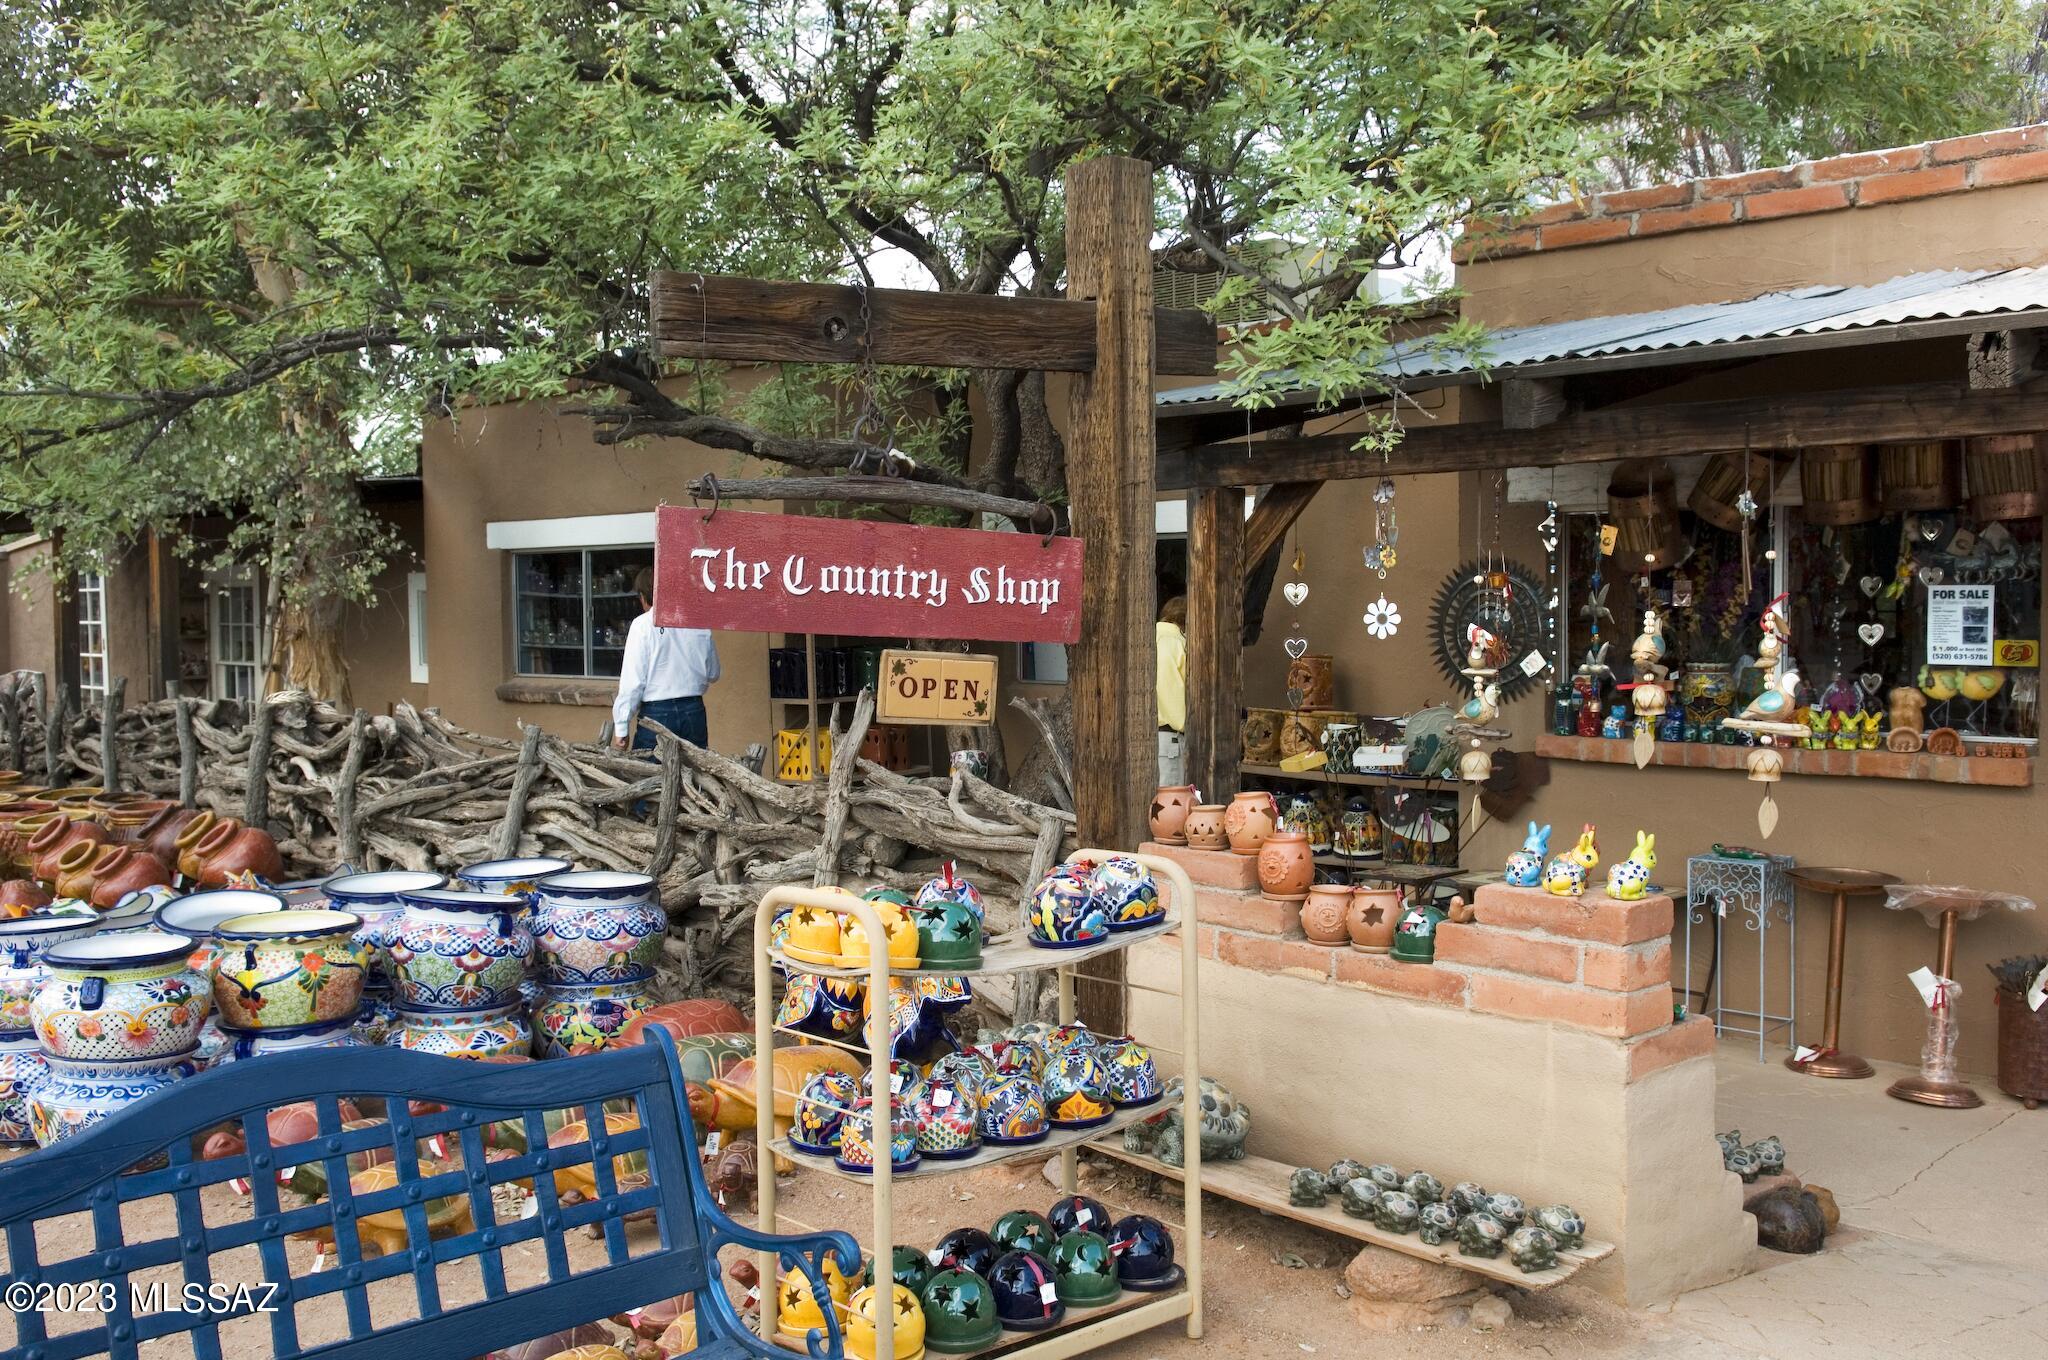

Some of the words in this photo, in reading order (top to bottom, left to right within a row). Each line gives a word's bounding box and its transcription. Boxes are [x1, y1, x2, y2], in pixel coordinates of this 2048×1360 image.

[690, 546, 770, 592] The
[782, 554, 948, 607] Country
[961, 565, 1060, 614] Shop
[1933, 590, 1955, 599] FOR
[1959, 590, 1989, 599] SALE
[898, 676, 980, 701] OPEN
